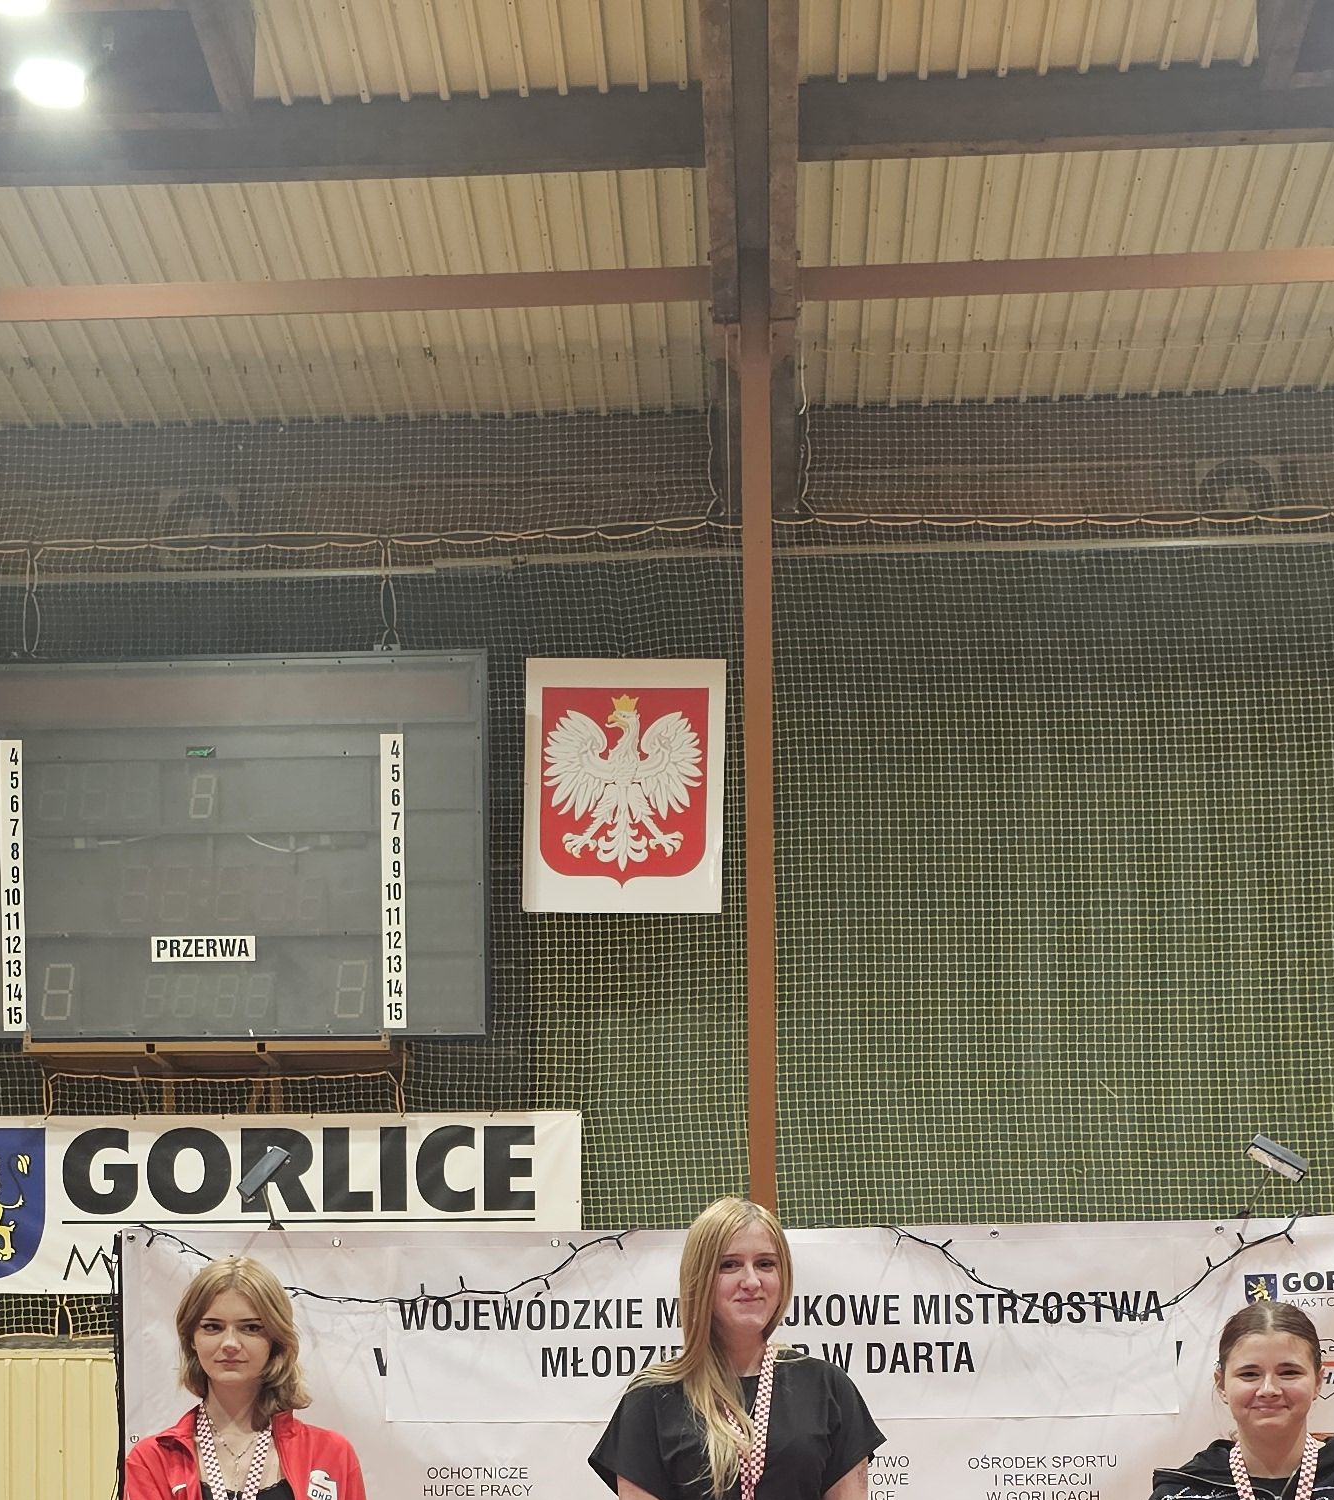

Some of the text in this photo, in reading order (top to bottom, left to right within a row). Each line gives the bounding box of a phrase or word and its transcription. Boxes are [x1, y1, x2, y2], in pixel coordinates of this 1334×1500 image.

[10, 747, 19, 766] 4
[391, 739, 400, 759] 4
[10, 770, 19, 789] 5
[391, 764, 400, 782] 5
[10, 794, 19, 813] 6
[391, 788, 400, 806] 6
[10, 818, 19, 837] 7
[391, 811, 401, 830] 7
[11, 842, 19, 861] 8
[392, 836, 401, 855] 8
[11, 865, 20, 884] 9
[392, 860, 401, 879] 9
[4, 888, 21, 906] 10
[385, 882, 402, 901] 10
[5, 912, 21, 930] 11
[385, 906, 401, 926] 11
[5, 935, 21, 954] 12
[156, 939, 250, 959] PRZERWA
[385, 930, 402, 950] 12
[5, 959, 22, 977] 13
[386, 954, 403, 973] 13
[5, 983, 23, 1002] 14
[386, 978, 403, 998] 14
[6, 1006, 23, 1025] 15
[386, 1002, 403, 1021] 15
[62, 1125, 535, 1215] GORLICE
[399, 1291, 643, 1331] WOJEWÓDZKIE
[913, 1291, 1165, 1326] MISTRZOSTWA
[822, 1343, 853, 1374] W
[867, 1341, 976, 1374] DARTA
[968, 1454, 1118, 1470] OŚRODEK SPORTU
[427, 1467, 528, 1480] OCHOTNICZE
[993, 1473, 1093, 1486] I REKREACJI
[423, 1484, 534, 1497] HUFCE PRACY
